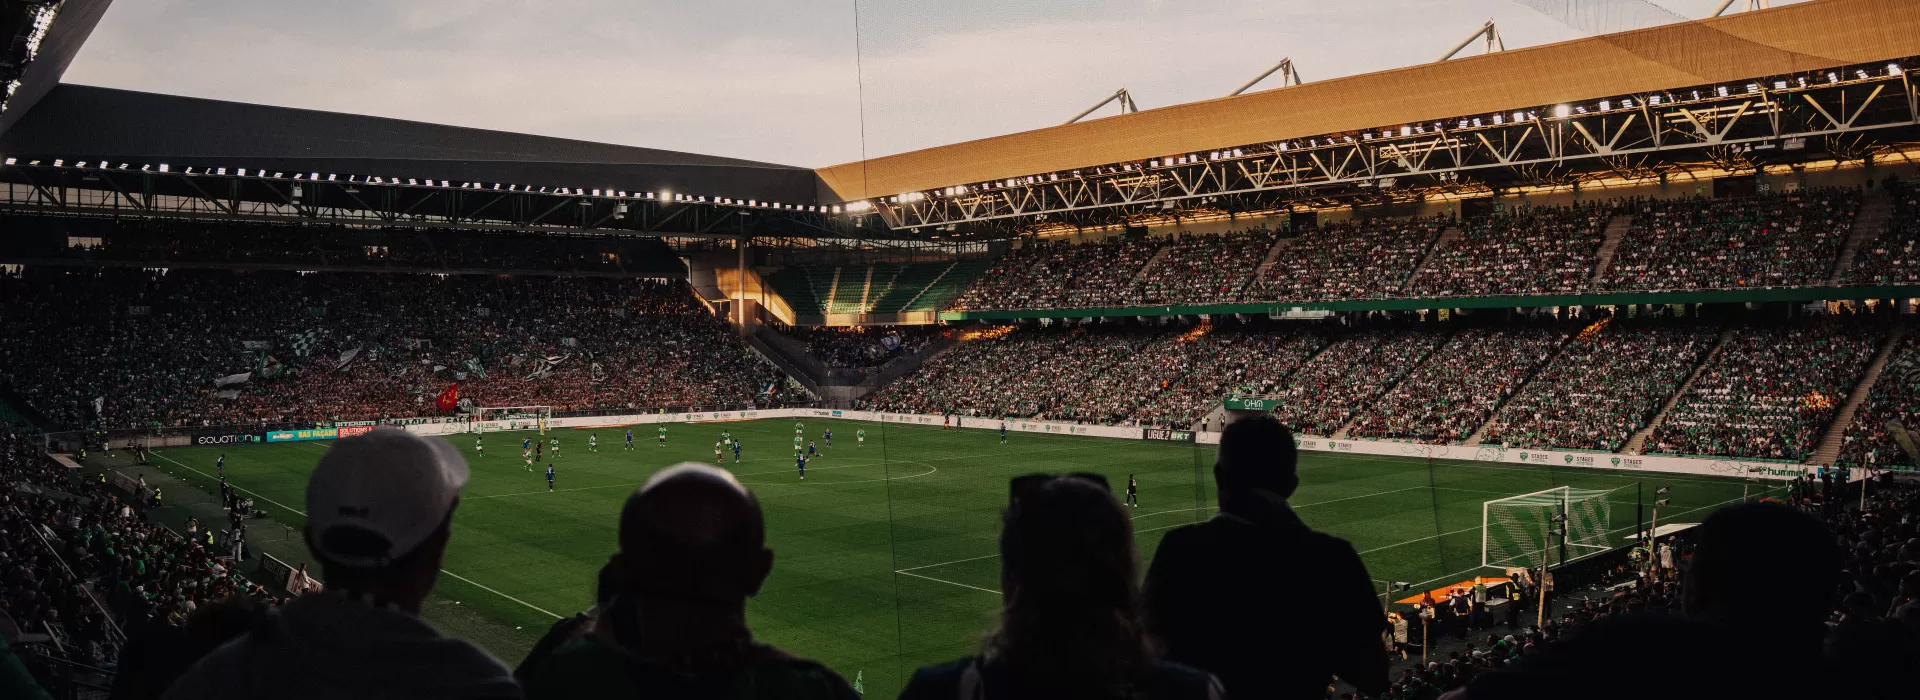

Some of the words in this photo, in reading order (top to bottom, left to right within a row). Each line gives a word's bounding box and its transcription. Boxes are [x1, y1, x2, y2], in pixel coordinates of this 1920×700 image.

[1147, 429, 1165, 440] LIGUE
[1165, 430, 1170, 440] 2
[1767, 467, 1805, 477] hummel
